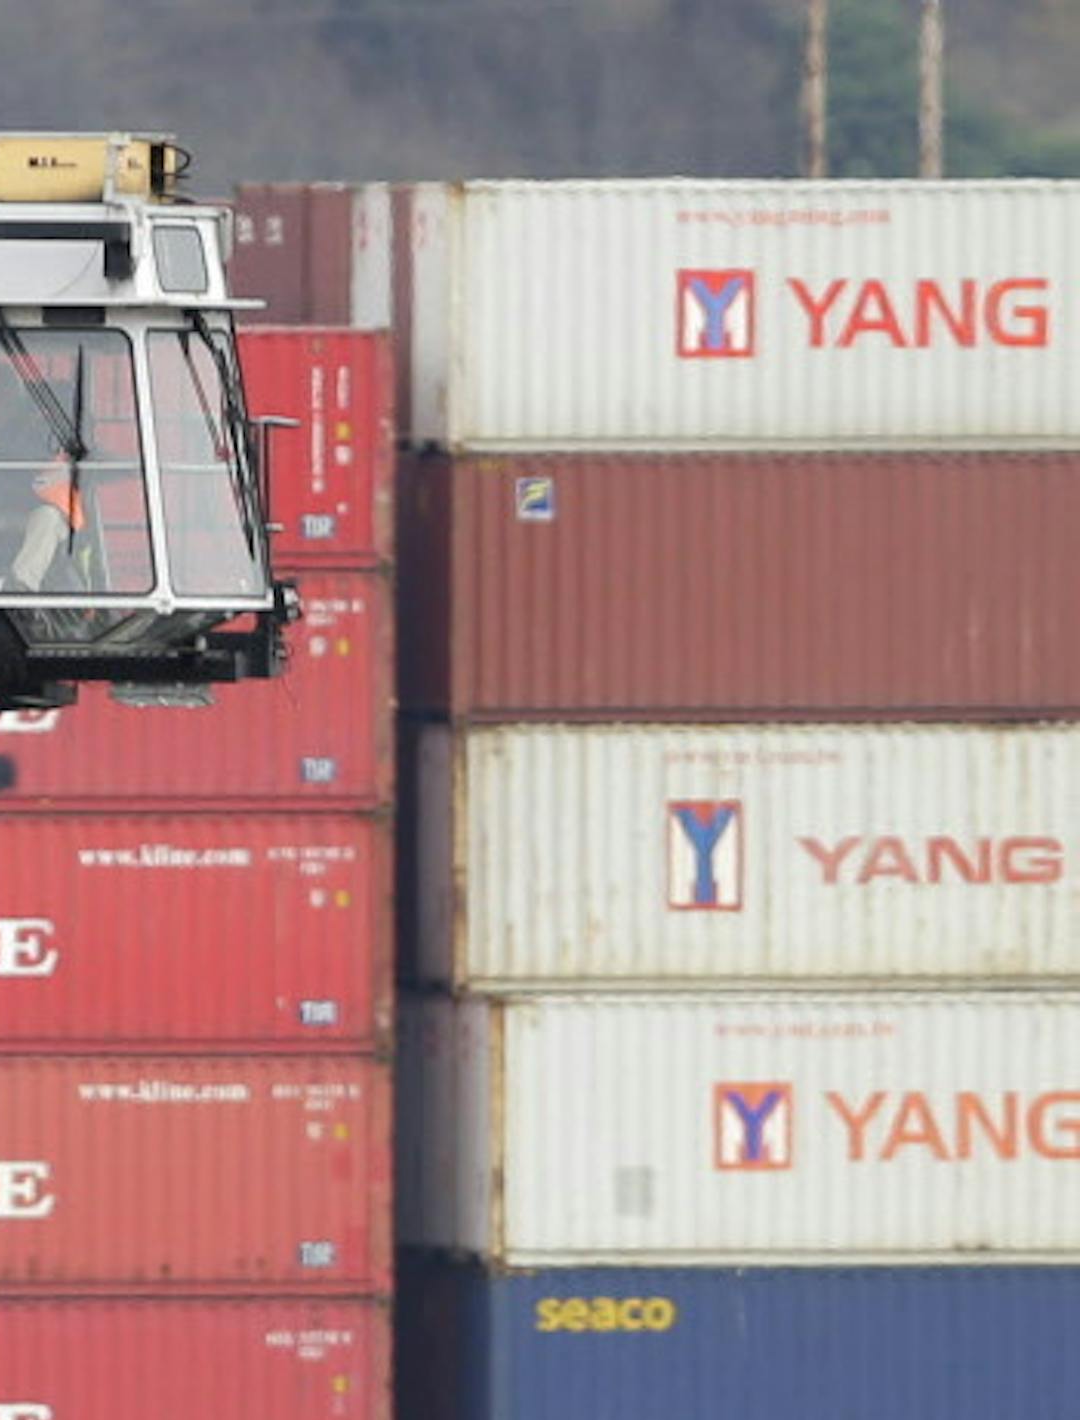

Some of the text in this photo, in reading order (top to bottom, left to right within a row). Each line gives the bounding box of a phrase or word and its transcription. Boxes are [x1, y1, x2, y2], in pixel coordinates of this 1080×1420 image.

[786, 277, 1049, 349] YANG
[77, 844, 251, 867] www.kline.com
[797, 835, 1064, 885] YANG
[824, 1091, 1080, 1161] YANG
[535, 1297, 677, 1333] seaco
